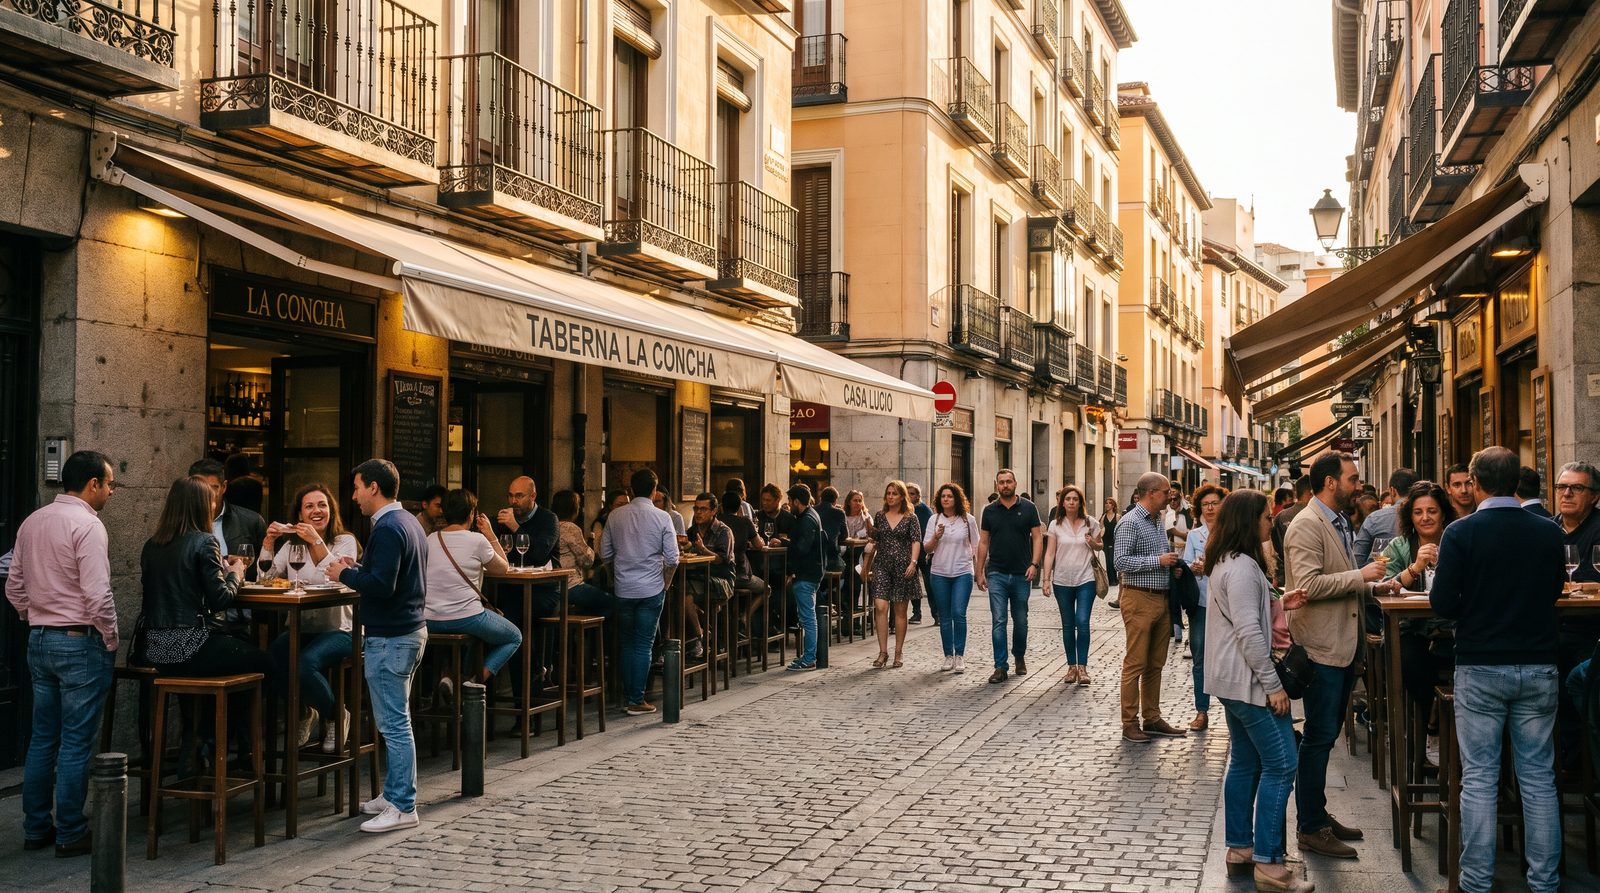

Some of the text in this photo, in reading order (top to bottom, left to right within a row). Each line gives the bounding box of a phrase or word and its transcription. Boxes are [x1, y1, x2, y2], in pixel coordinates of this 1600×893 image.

[247, 287, 346, 329] LA CONCHA
[527, 313, 621, 363] TABERNA
[626, 336, 648, 368] LA
[653, 342, 717, 380] CONCHA
[843, 383, 893, 412] CASA LUCIO
